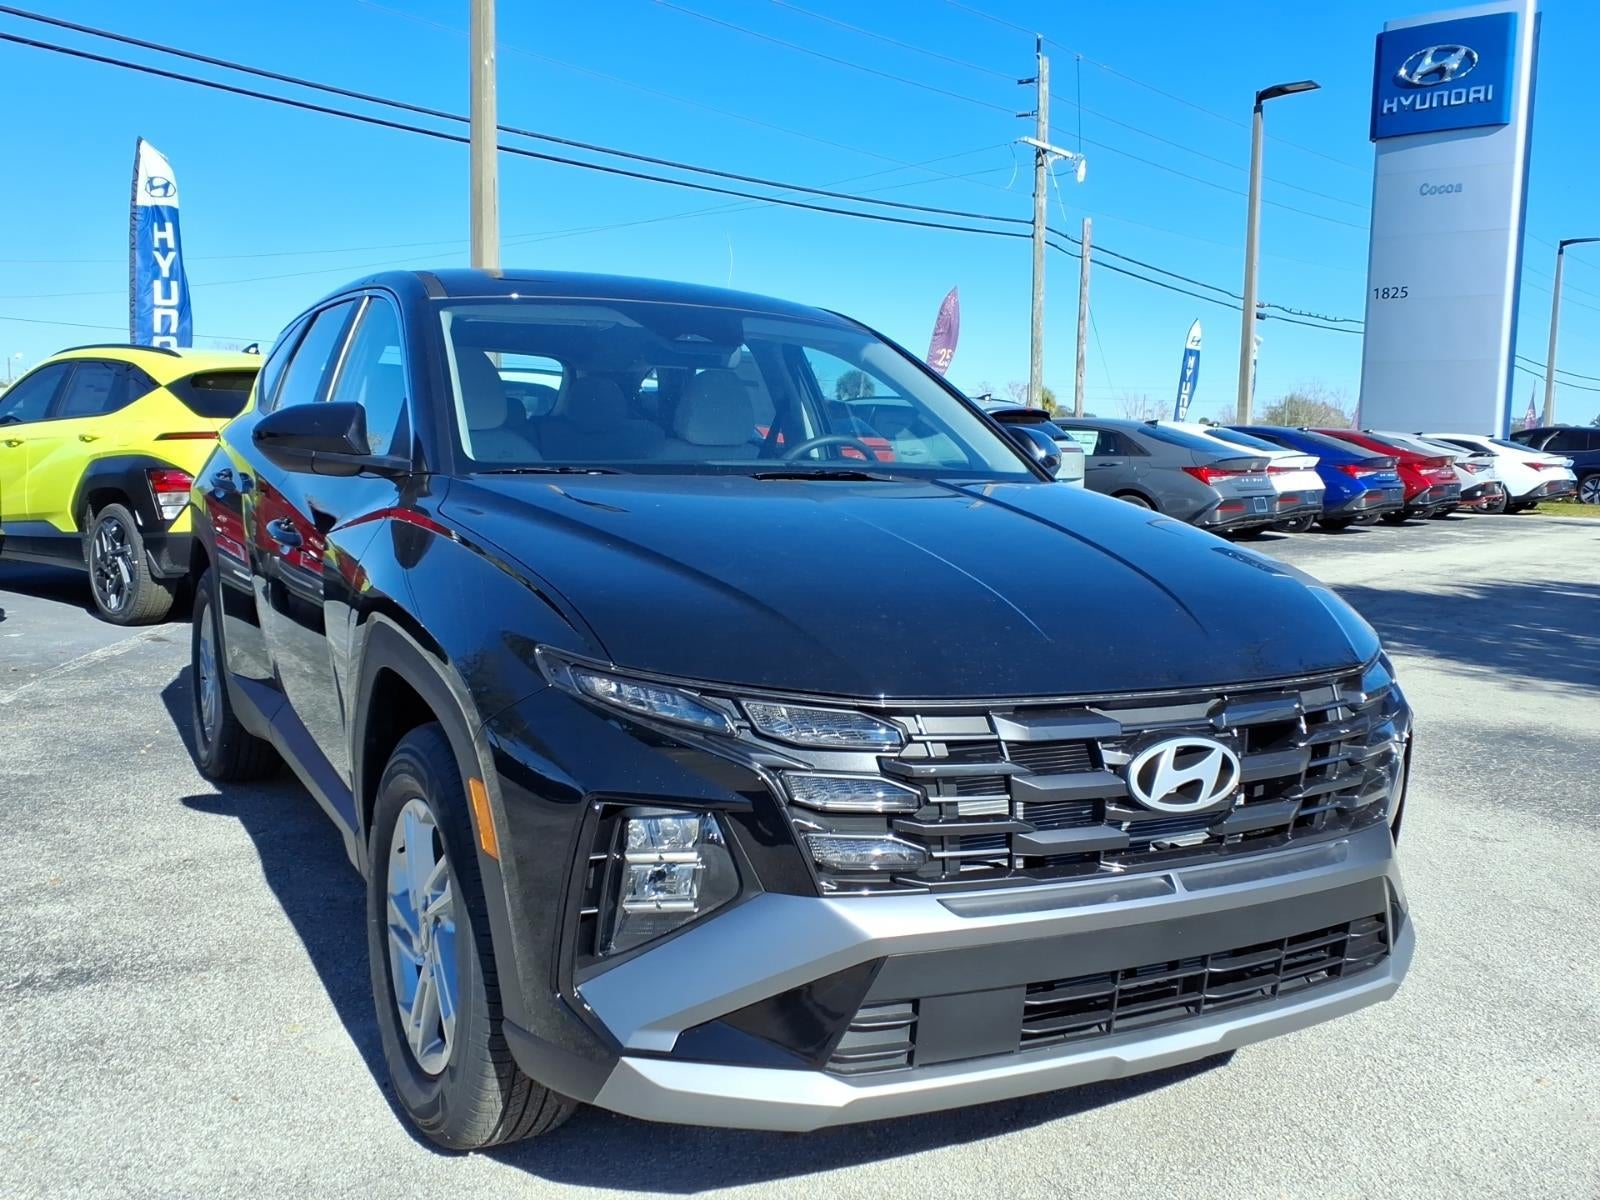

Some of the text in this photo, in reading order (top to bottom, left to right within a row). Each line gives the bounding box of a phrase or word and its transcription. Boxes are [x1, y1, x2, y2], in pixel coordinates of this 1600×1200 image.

[1382, 84, 1494, 114] HYUNDAI
[1419, 182, 1463, 197] Cocoa
[1373, 285, 1409, 301] 1825
